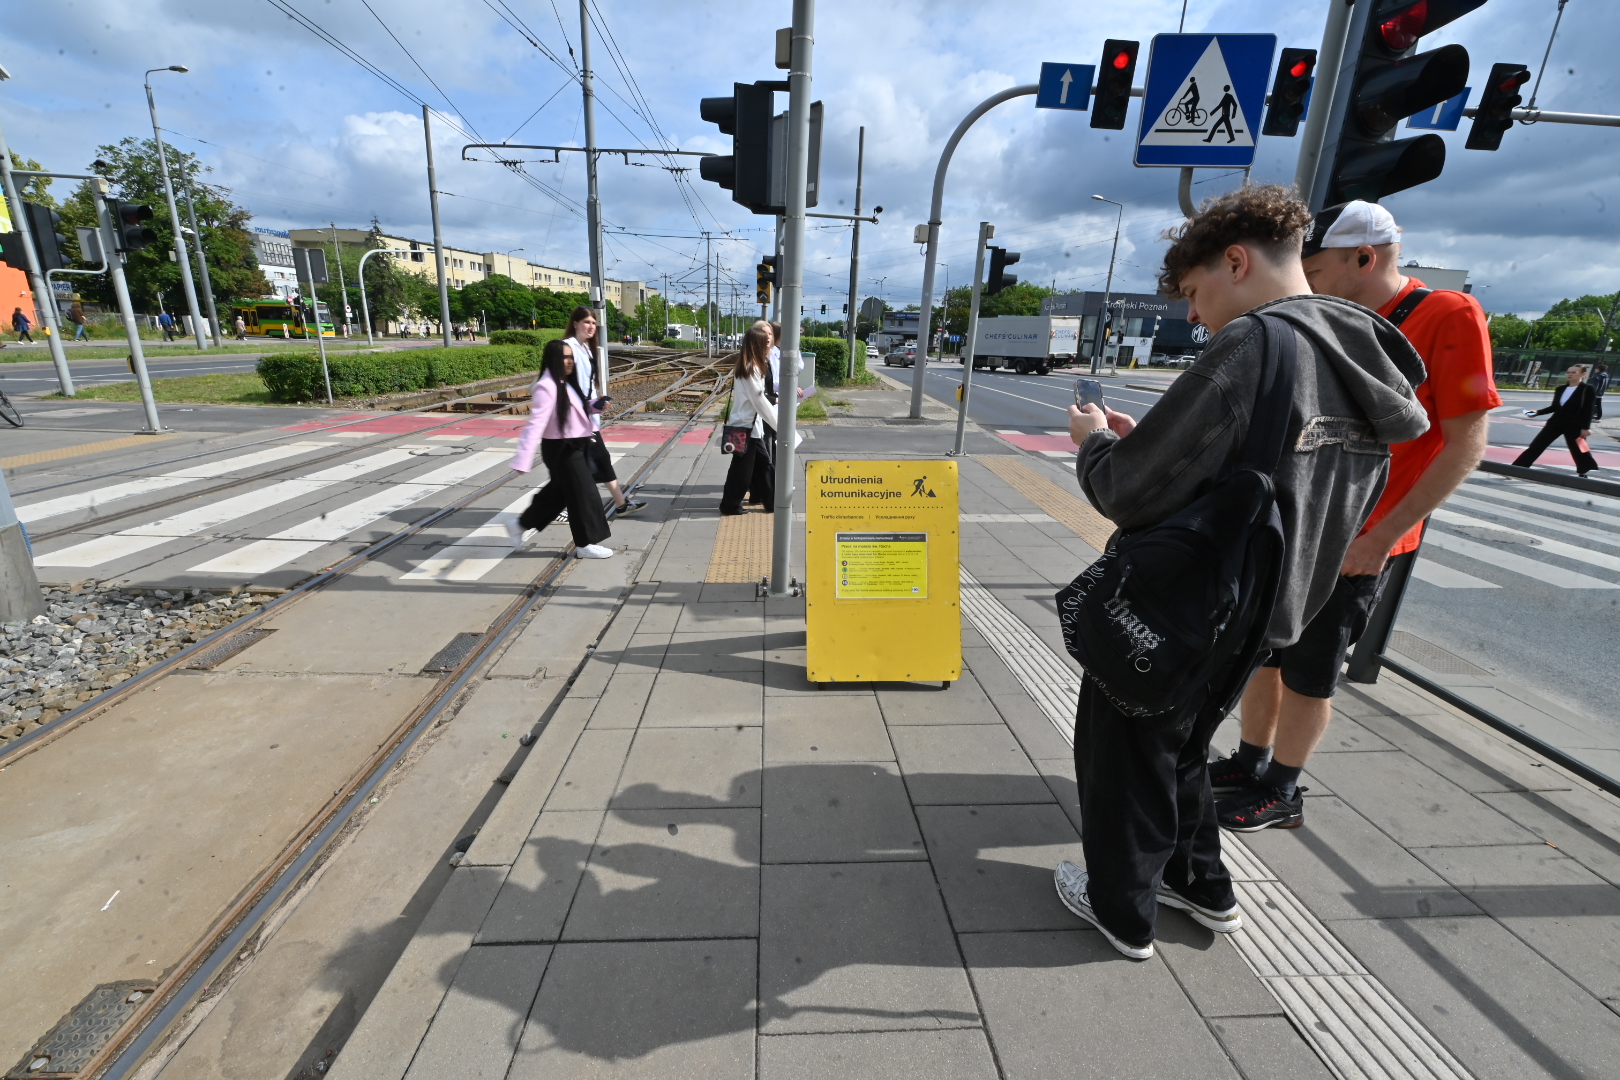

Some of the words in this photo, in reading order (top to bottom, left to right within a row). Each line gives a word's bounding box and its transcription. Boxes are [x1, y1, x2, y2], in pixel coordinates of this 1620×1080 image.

[1139, 302, 1168, 311] Poznań
[1193, 326, 1209, 341] MG
[820, 475, 883, 485] Utrudnienia
[820, 489, 902, 500] komunikacyjne
